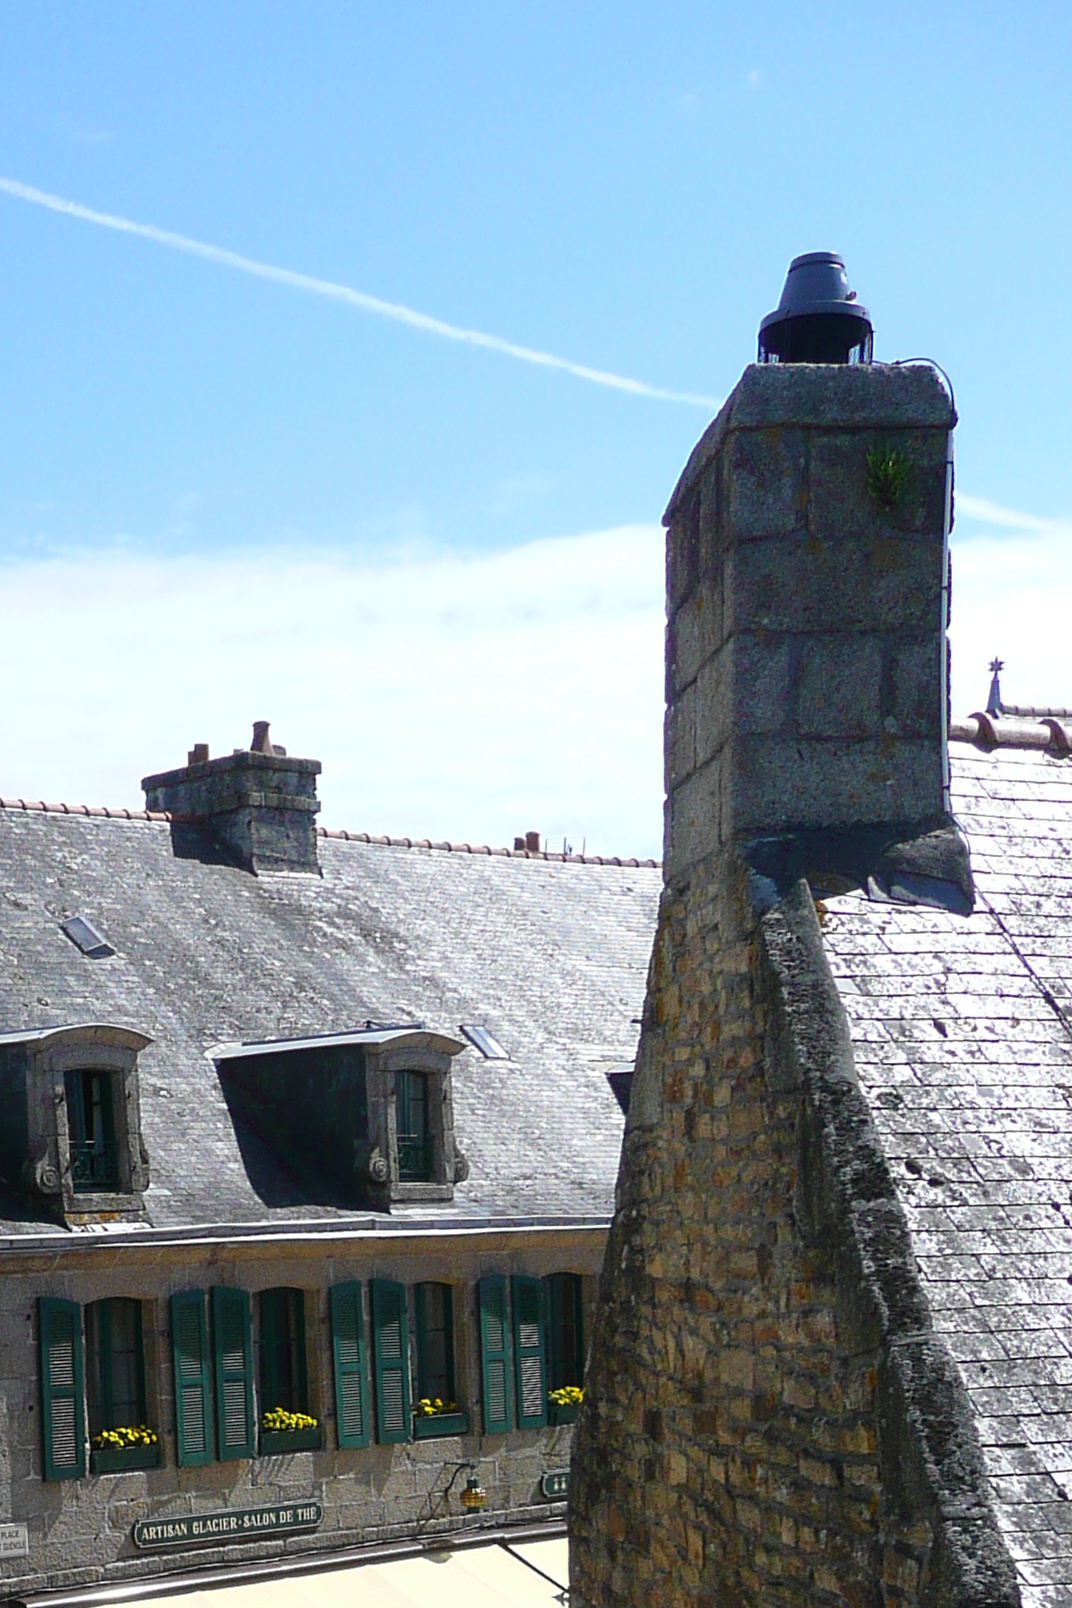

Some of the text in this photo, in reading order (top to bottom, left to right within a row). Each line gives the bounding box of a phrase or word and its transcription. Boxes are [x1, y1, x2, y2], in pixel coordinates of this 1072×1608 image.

[142, 1521, 188, 1540] ARTISAN
[193, 1517, 238, 1534] GLACIER
[243, 1511, 276, 1528] SALON
[279, 1510, 294, 1523] DE
